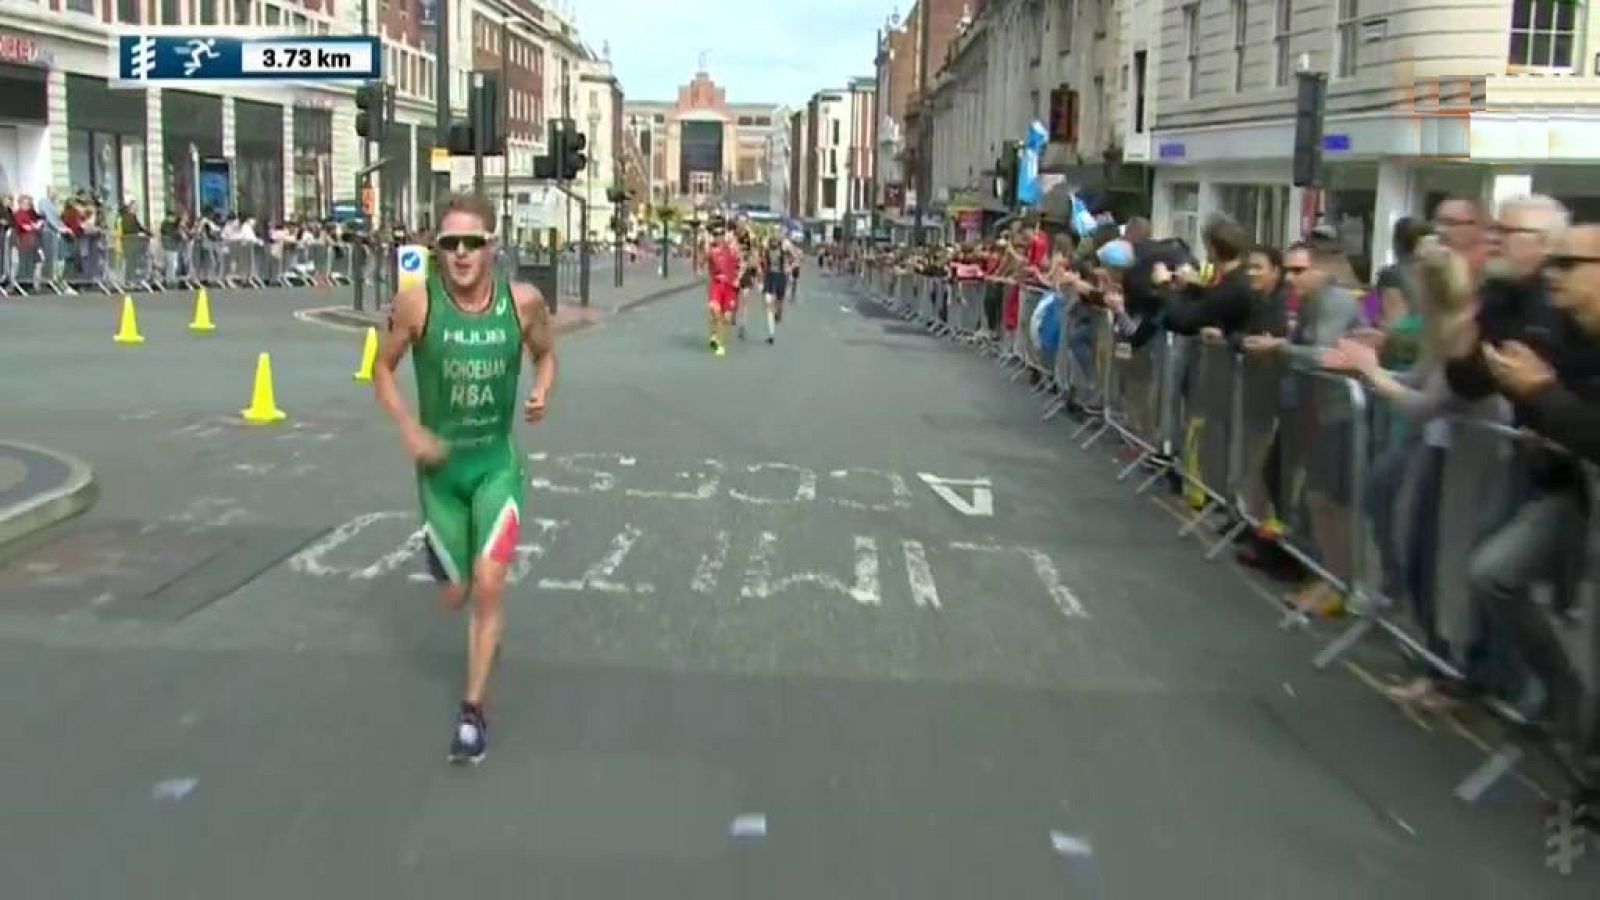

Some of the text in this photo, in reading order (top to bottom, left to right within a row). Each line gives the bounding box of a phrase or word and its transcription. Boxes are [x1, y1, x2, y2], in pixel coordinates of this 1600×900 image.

[442, 328, 508, 345] HUUB
[450, 384, 495, 407] RSA
[524, 452, 993, 518] ACCES
